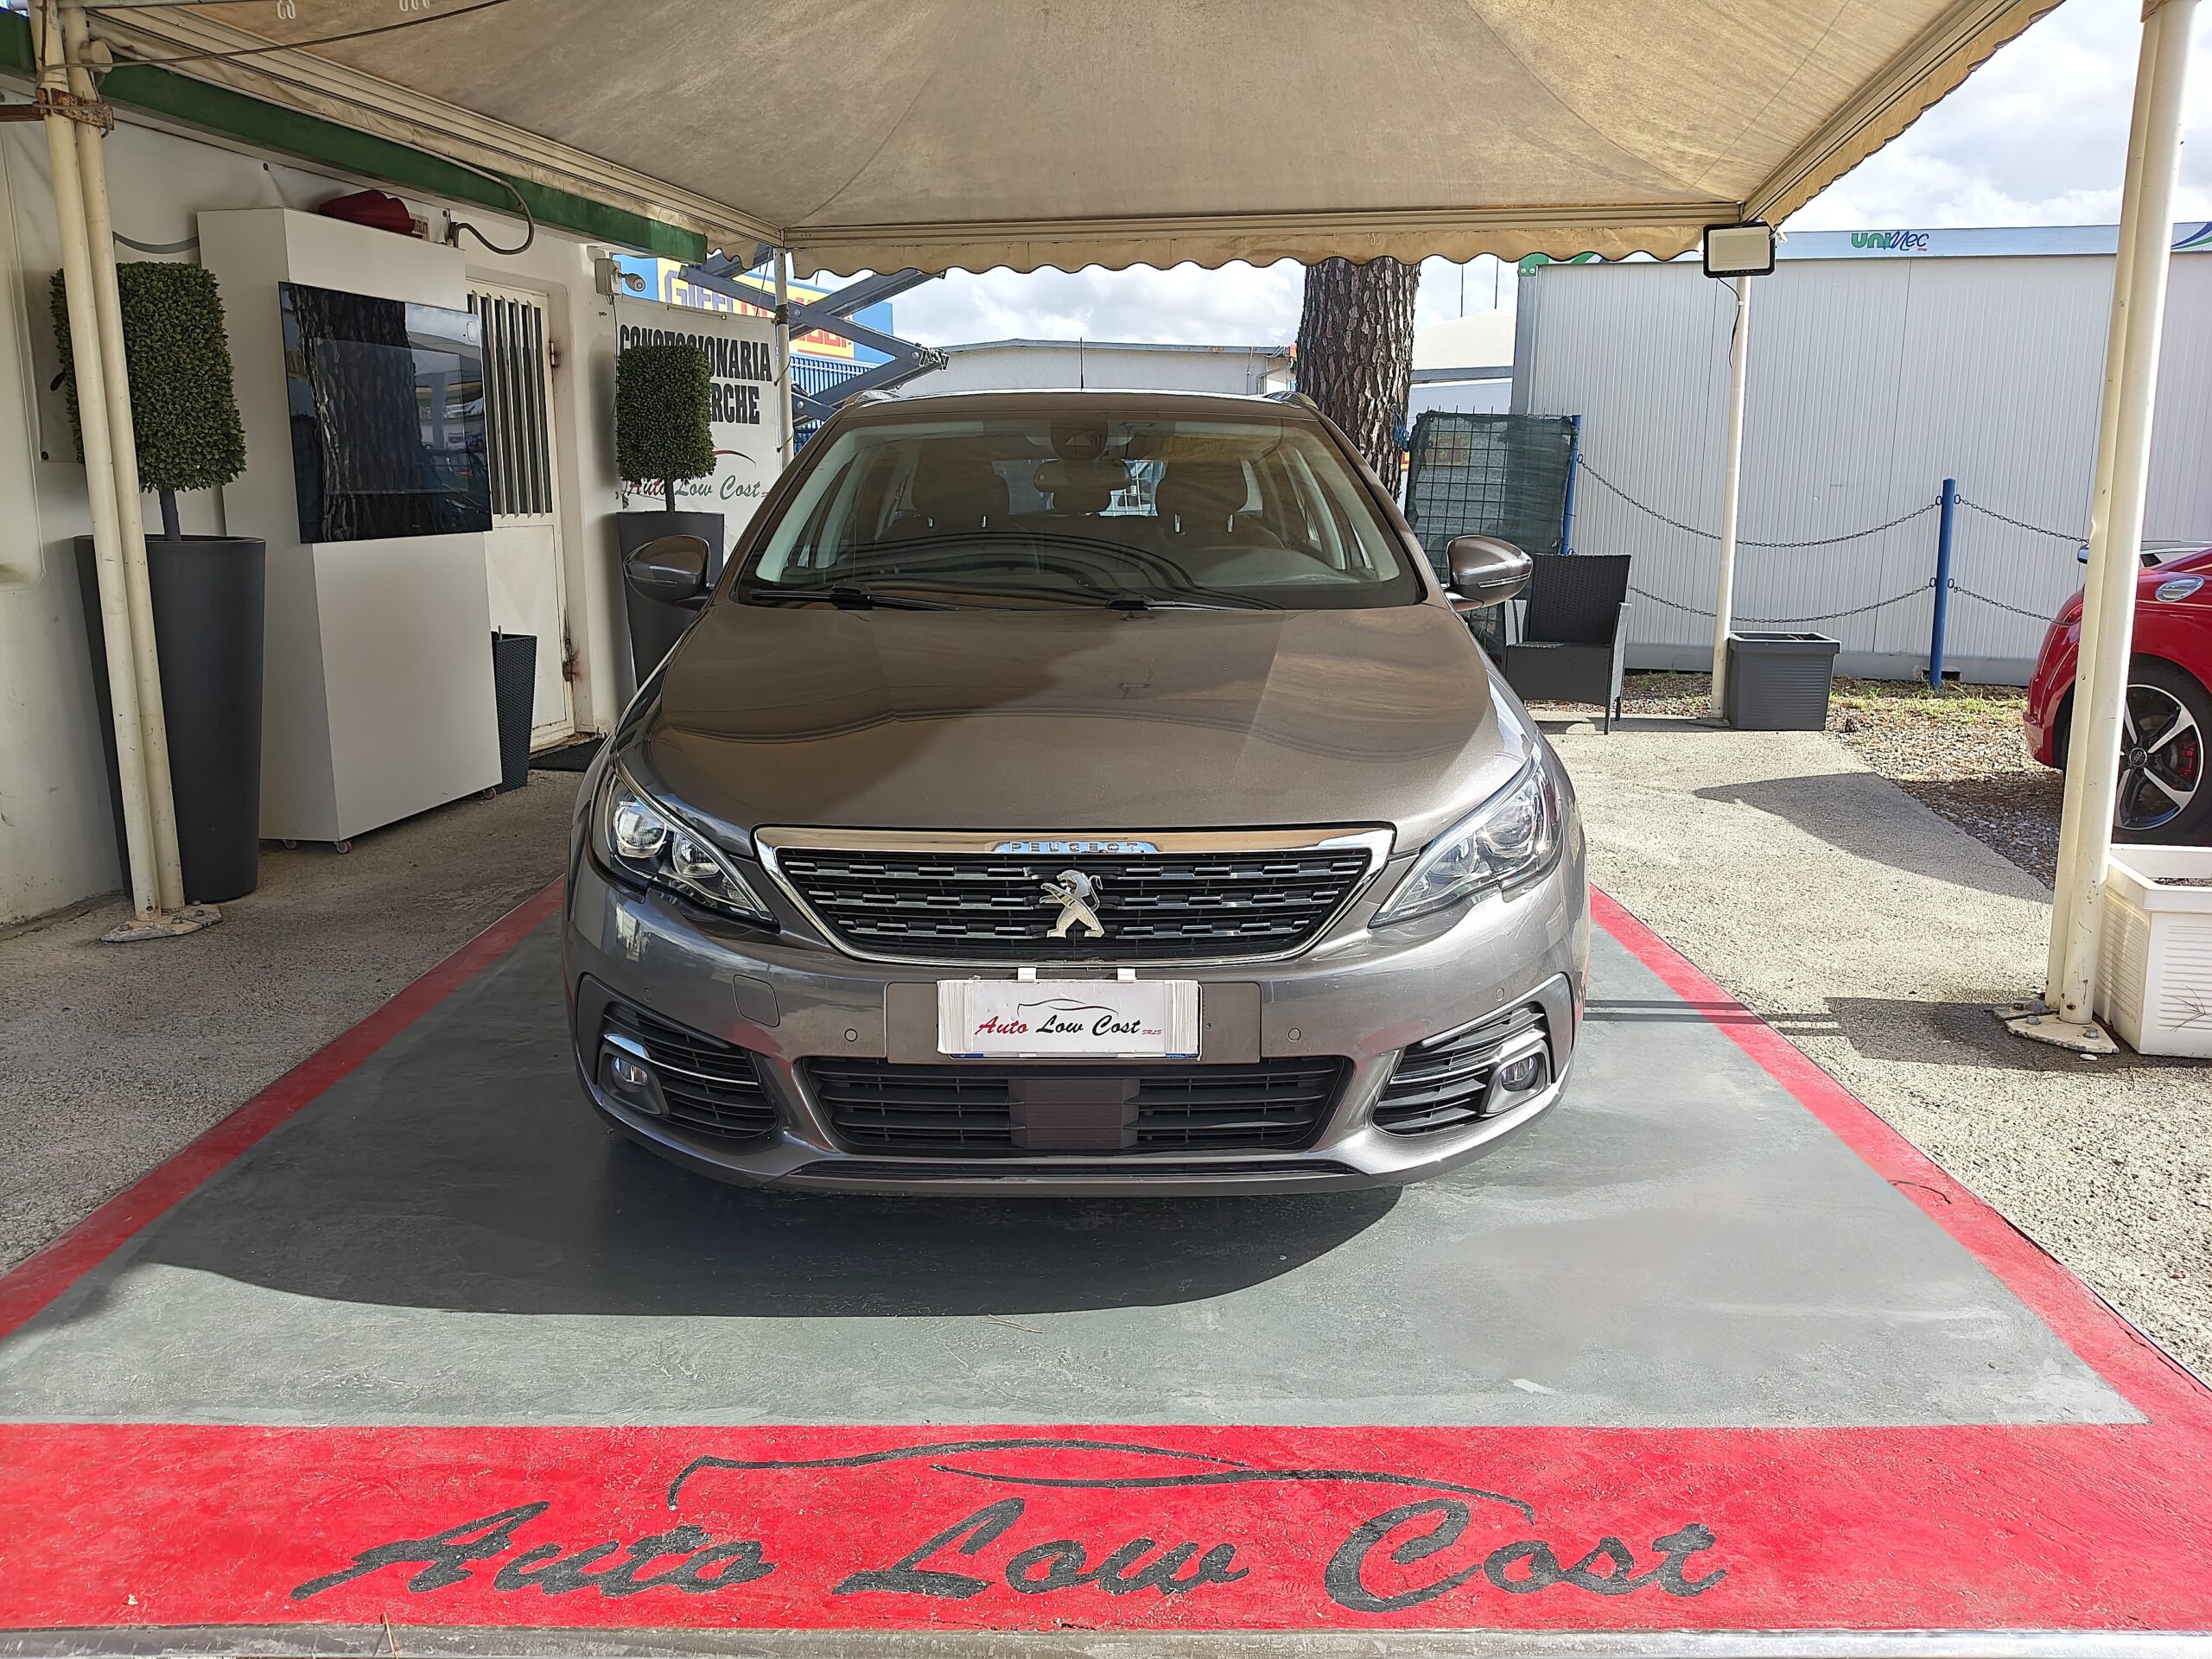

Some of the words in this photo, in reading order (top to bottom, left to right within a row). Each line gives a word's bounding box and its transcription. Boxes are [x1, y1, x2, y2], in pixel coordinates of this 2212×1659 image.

[675, 480, 712, 496] Low
[720, 474, 761, 500] Cost
[1009, 842, 1138, 852] PEUGEOT
[975, 1015, 1028, 1035] Auto
[1036, 1014, 1084, 1034] Low
[1091, 1014, 1141, 1036] Cost
[290, 1501, 778, 1600] Auto
[832, 1497, 1250, 1599] Low
[1324, 1498, 1728, 1613] Cost
